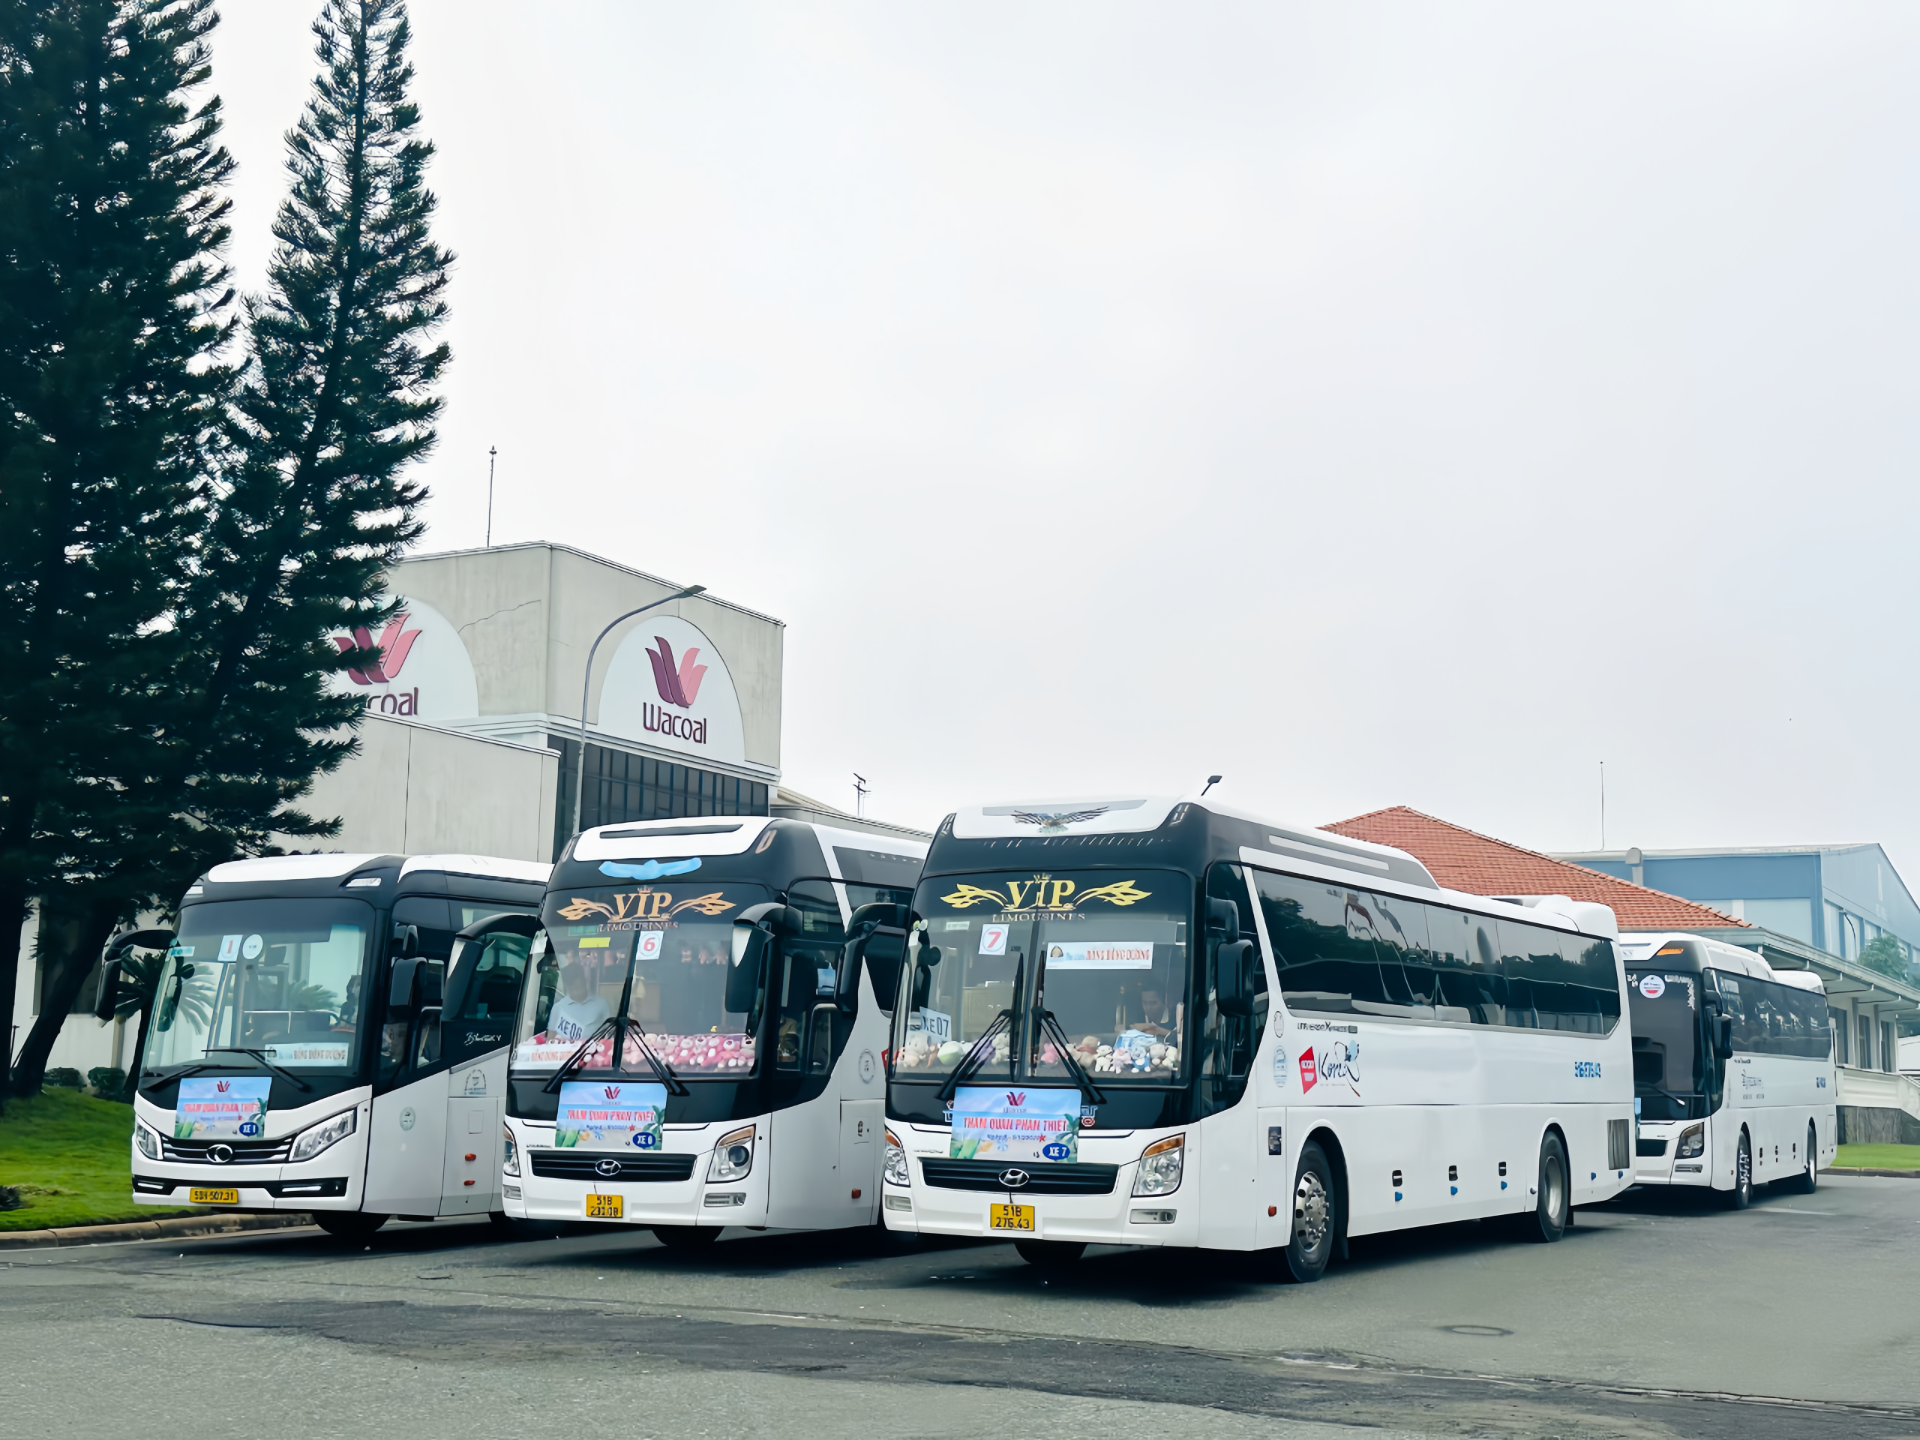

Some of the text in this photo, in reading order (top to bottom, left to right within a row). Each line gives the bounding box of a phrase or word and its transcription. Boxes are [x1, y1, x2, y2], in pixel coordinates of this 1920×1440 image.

[643, 702, 706, 745] Wacoal
[1006, 880, 1076, 908] VIP
[613, 892, 672, 919] VIP
[992, 912, 1086, 923] LIMOUSINES
[643, 937, 656, 952] 6
[988, 931, 1002, 949] 7
[963, 1116, 987, 1129] THAM
[989, 1117, 1013, 1131] QUAN
[1015, 1118, 1040, 1131] PHAN
[1048, 1146, 1068, 1157] XE 7
[1003, 1205, 1022, 1217] 51B
